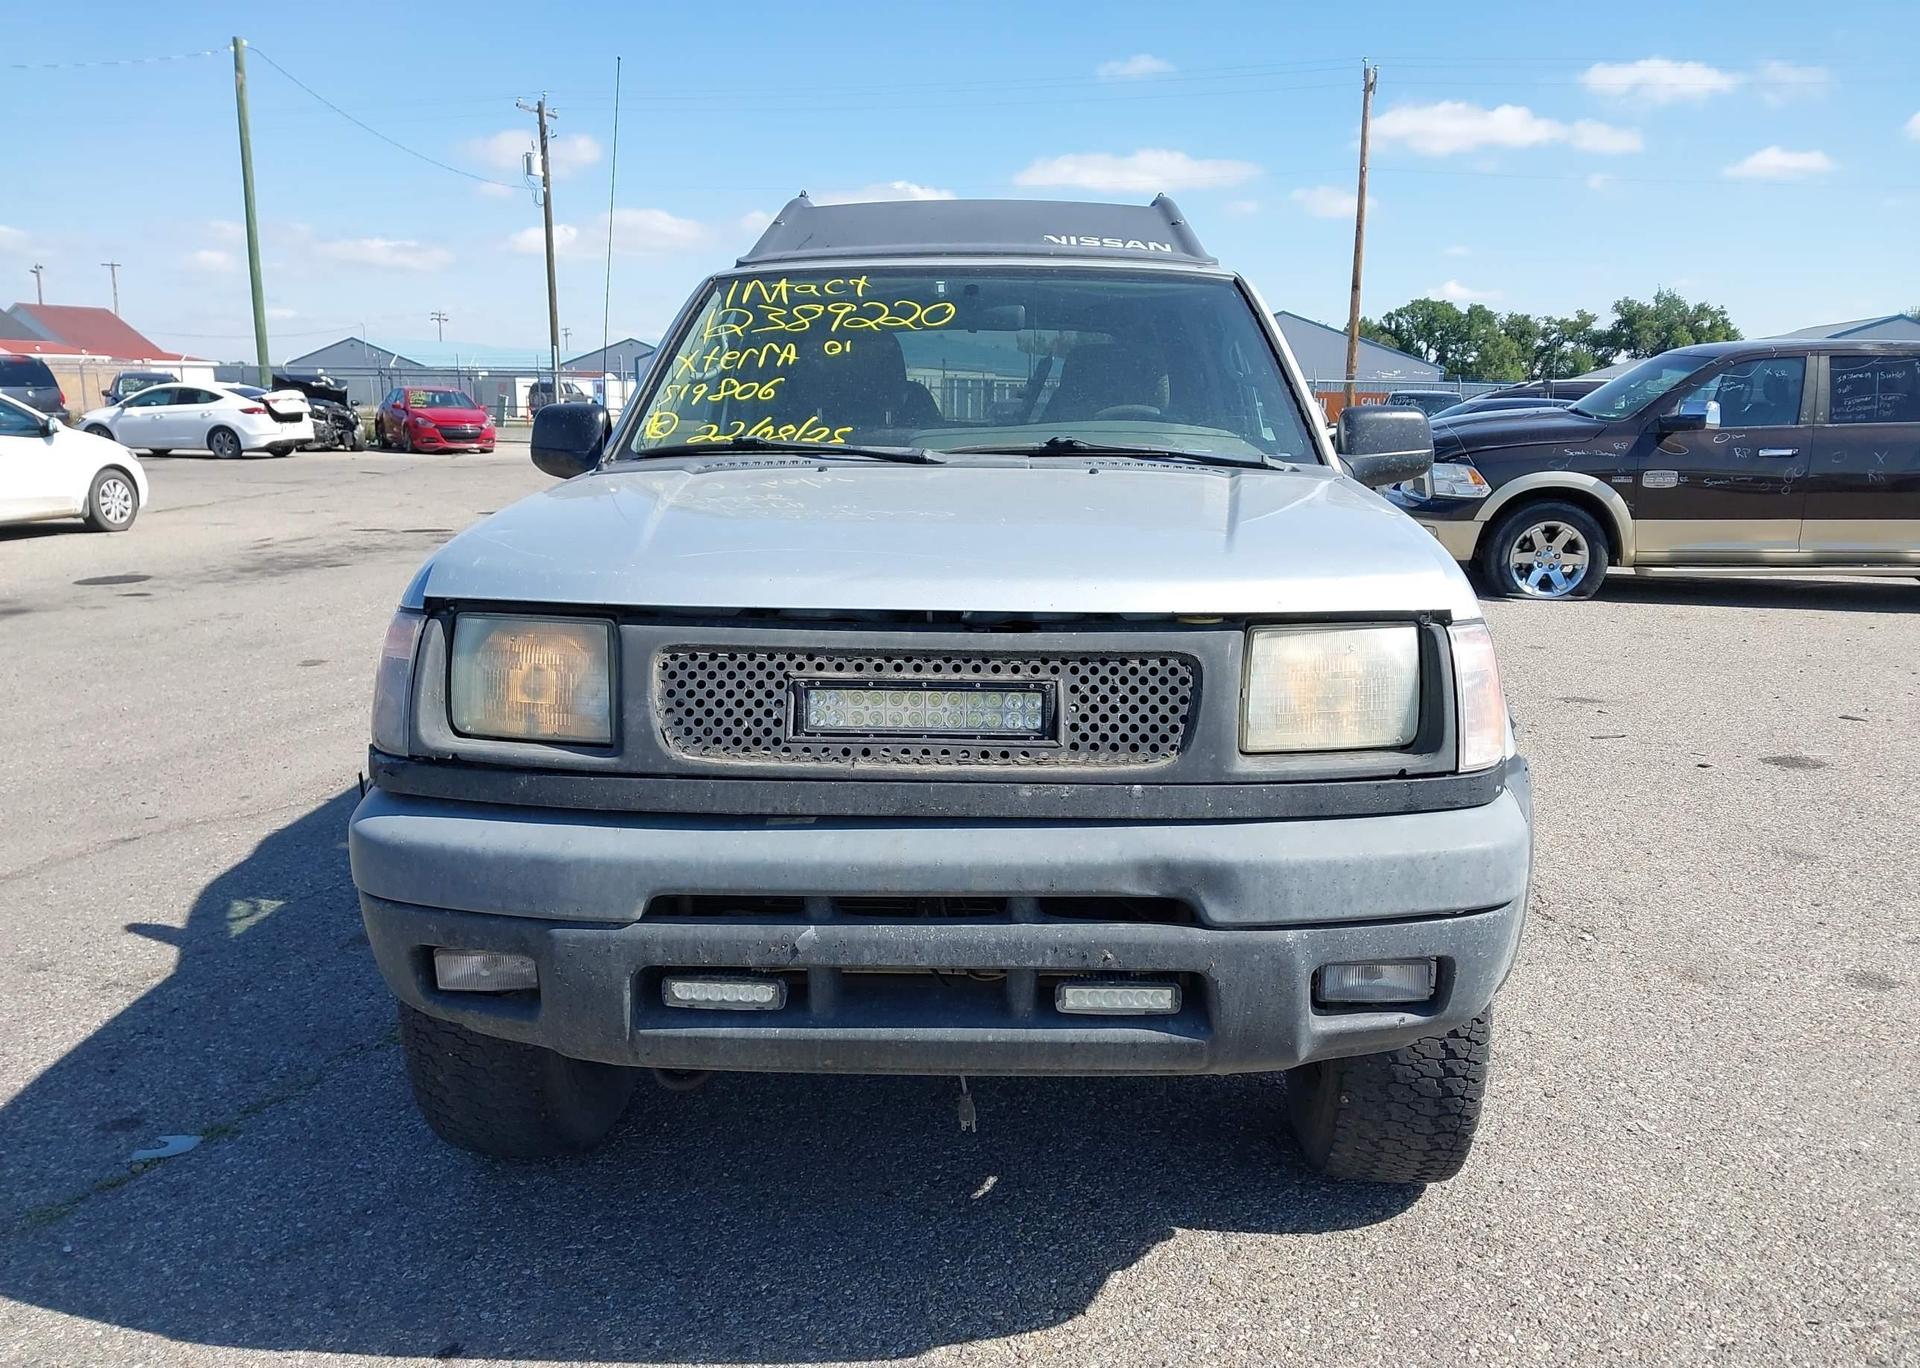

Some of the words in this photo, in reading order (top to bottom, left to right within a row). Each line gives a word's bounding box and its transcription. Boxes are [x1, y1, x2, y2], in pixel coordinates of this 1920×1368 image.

[1044, 235, 1172, 252] NISSAN
[703, 300, 956, 344] 12389220
[657, 377, 785, 406] 519806
[1361, 397, 1381, 406] CALL
